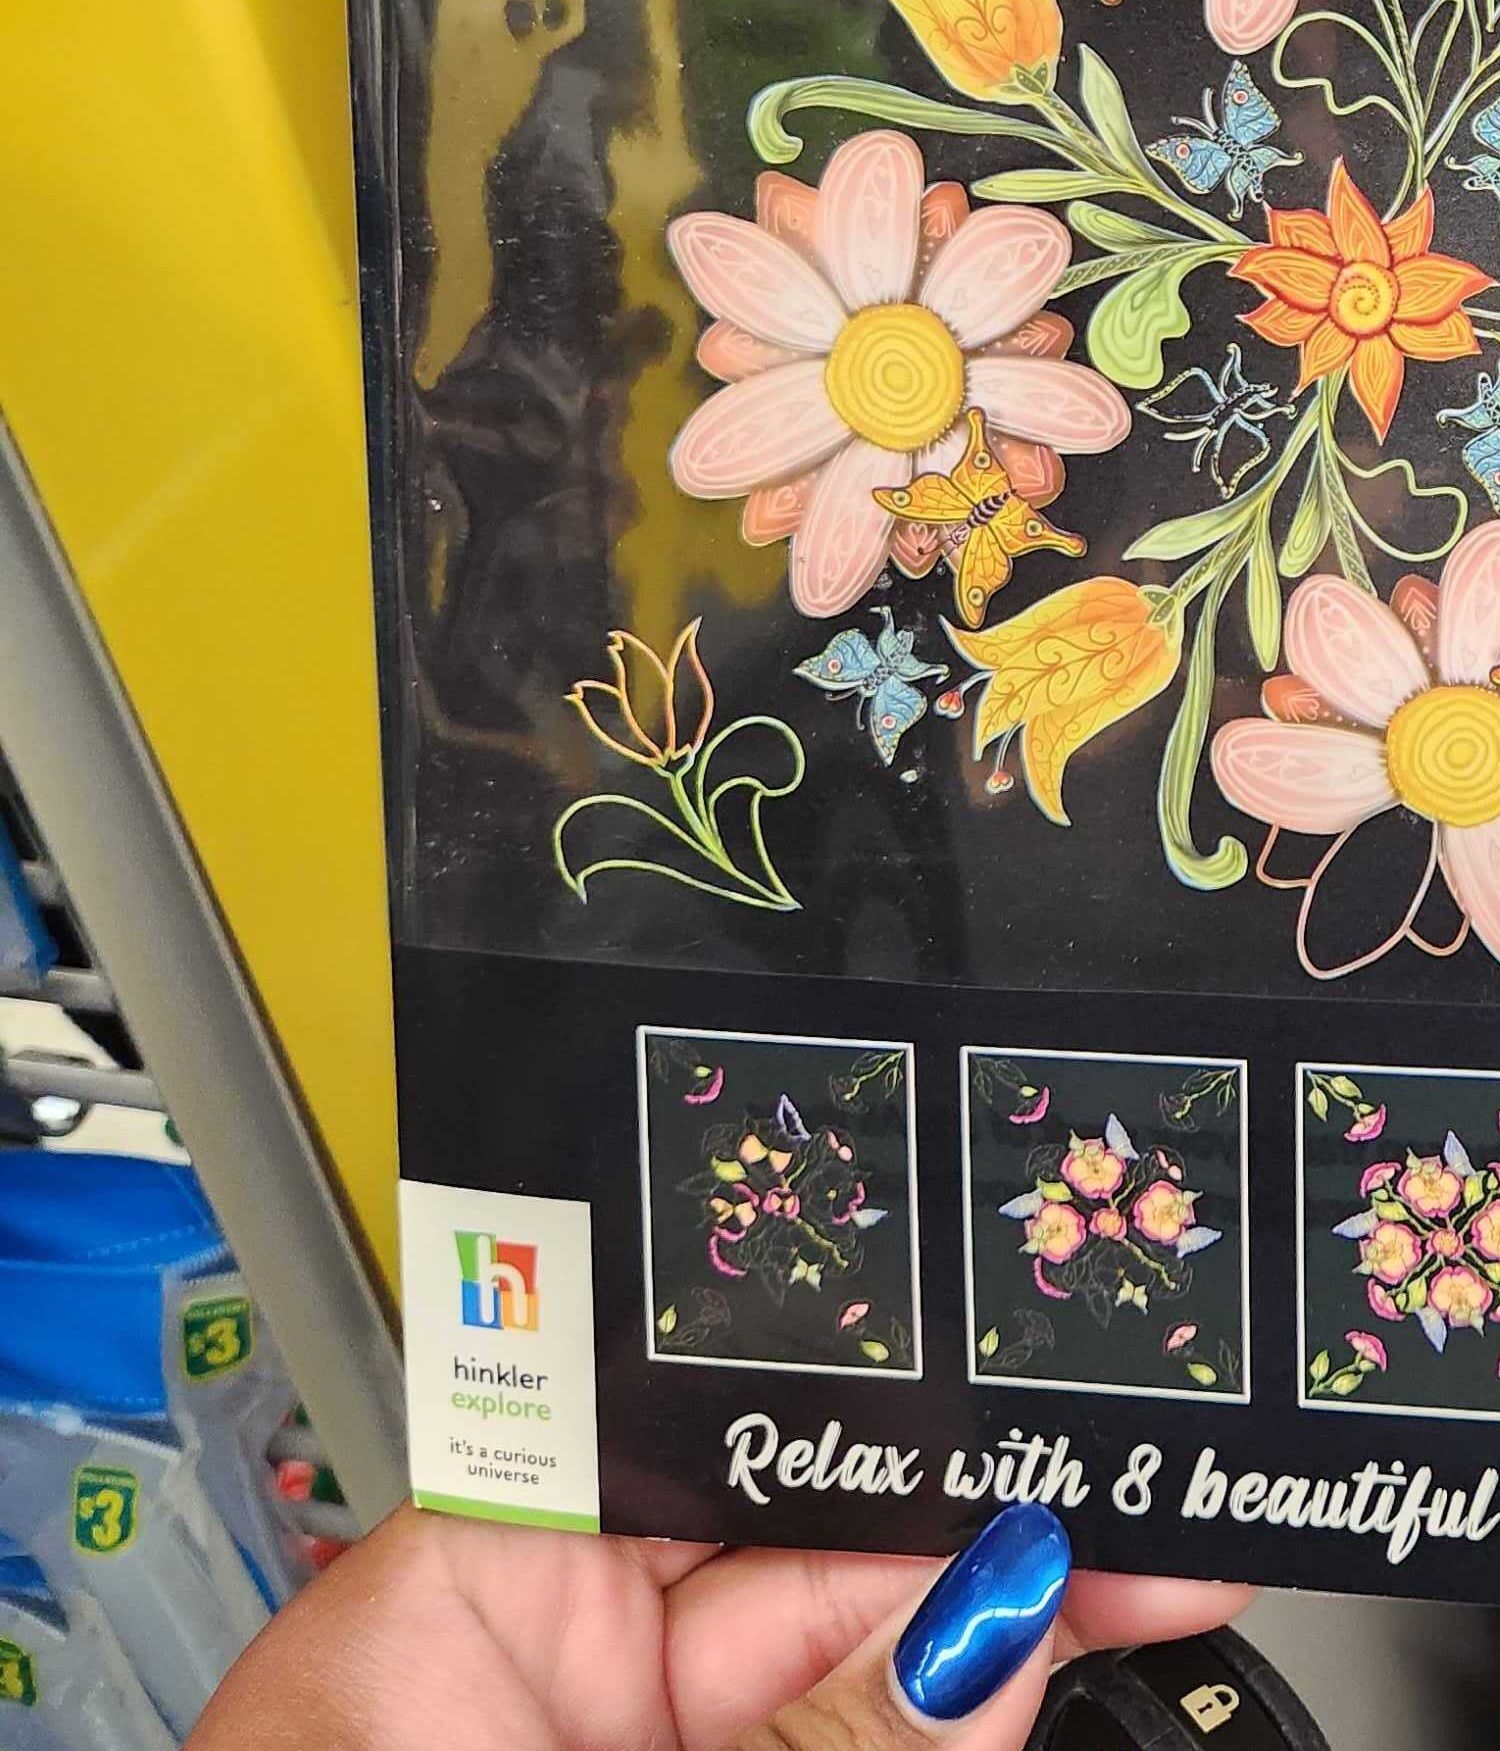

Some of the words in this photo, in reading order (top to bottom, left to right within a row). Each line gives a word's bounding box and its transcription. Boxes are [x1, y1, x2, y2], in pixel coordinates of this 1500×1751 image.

[453, 1355, 549, 1391] hinkler
[451, 1389, 552, 1421] explore
[449, 1436, 474, 1457] it's
[479, 1445, 489, 1459] a
[494, 1446, 557, 1469] curious
[724, 1411, 925, 1506] Relax
[943, 1427, 1092, 1508] with
[1111, 1443, 1163, 1516] 8
[467, 1462, 540, 1485] universe
